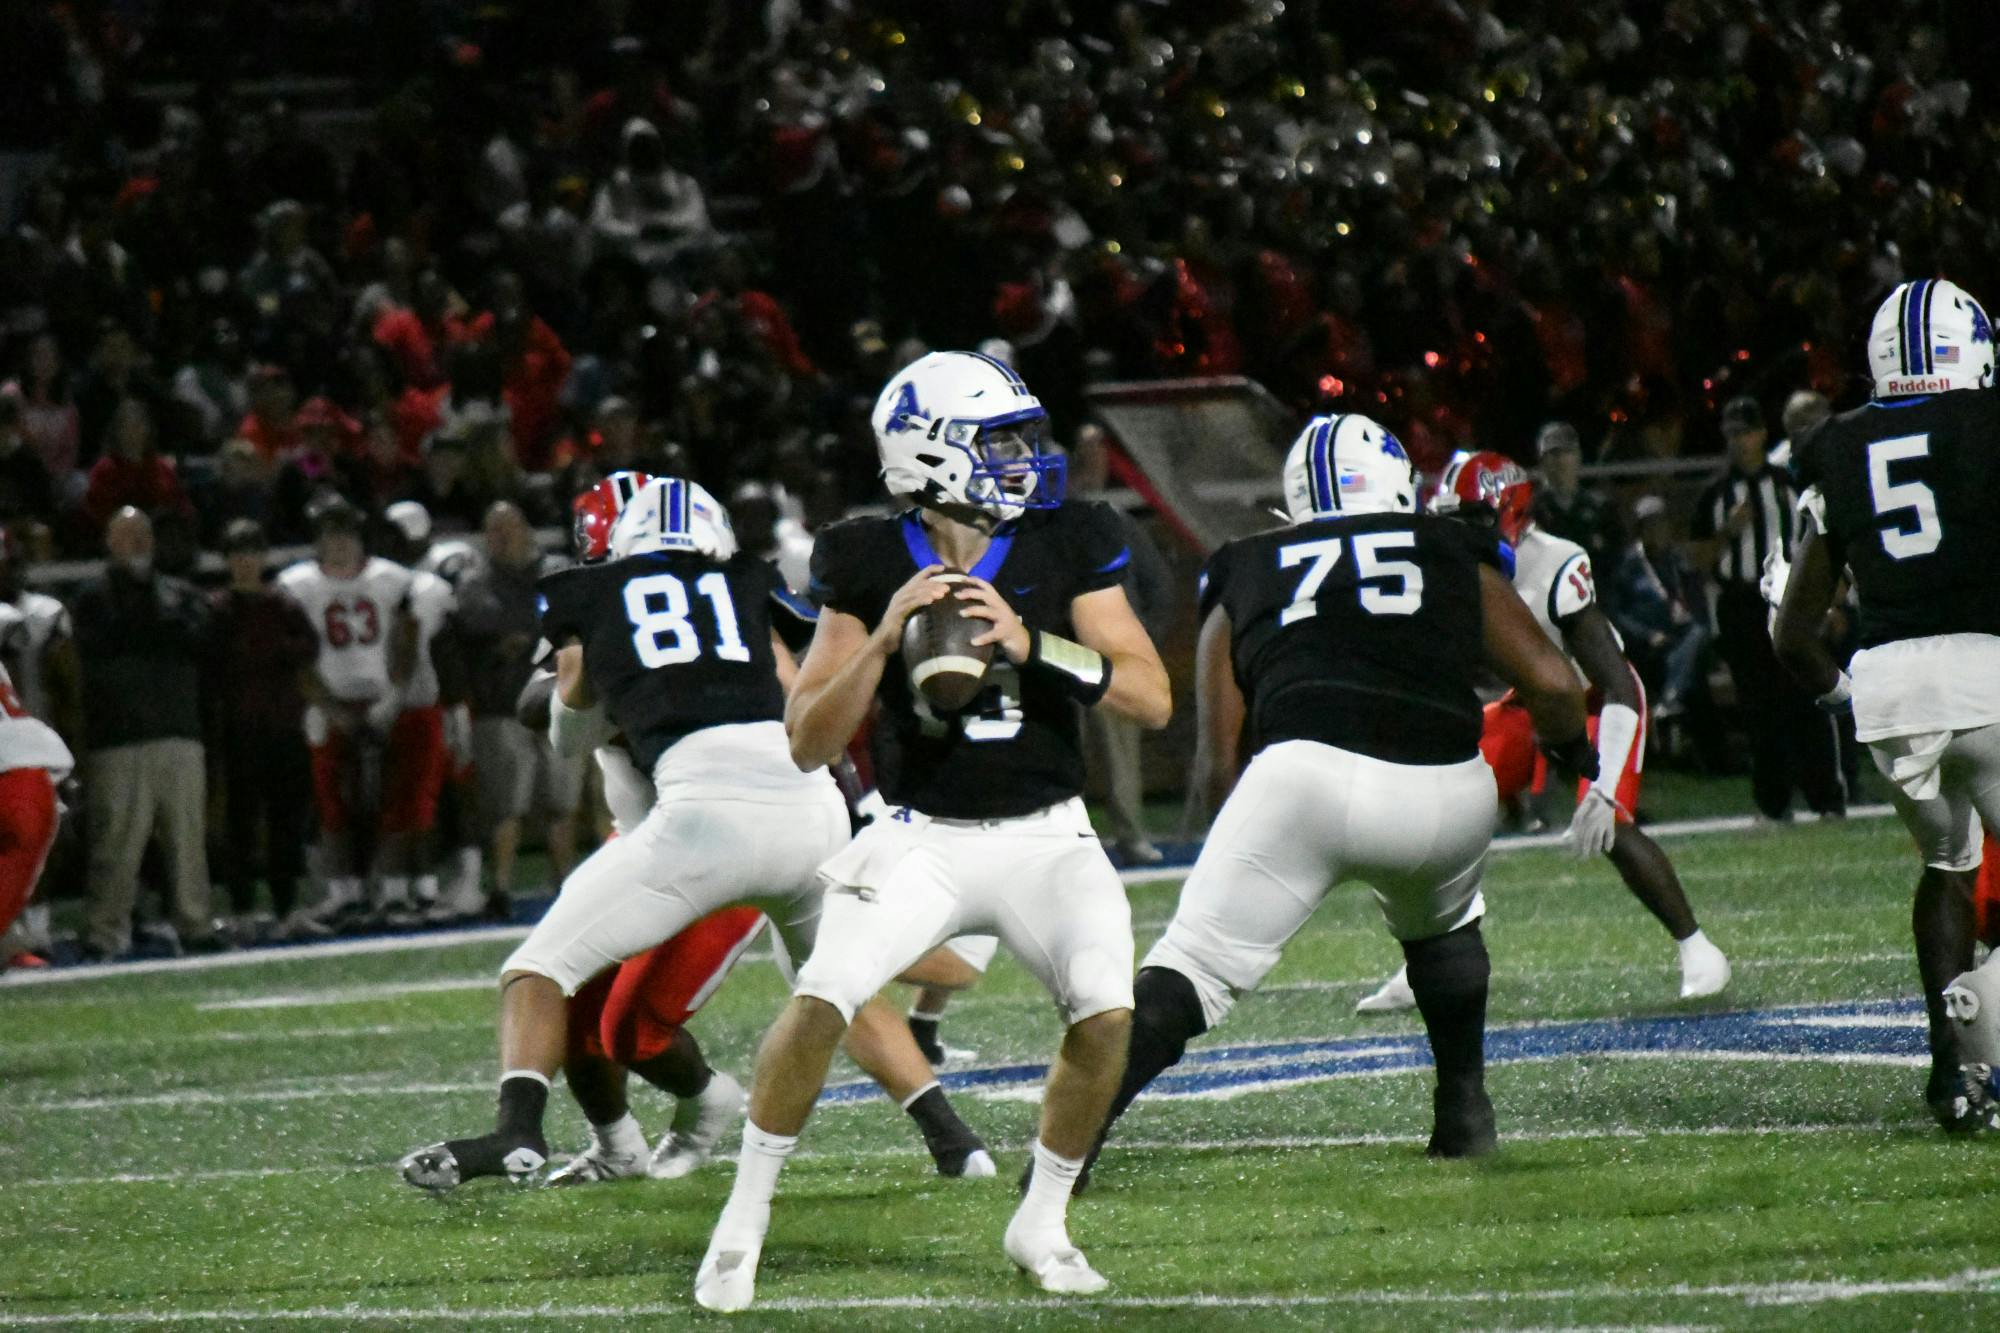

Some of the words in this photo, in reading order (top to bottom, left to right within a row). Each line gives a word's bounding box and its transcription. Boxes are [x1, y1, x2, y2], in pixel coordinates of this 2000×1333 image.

[1888, 377, 1951, 394] Riddell
[1867, 433, 1942, 560] 5
[324, 599, 380, 648] 63
[622, 572, 751, 669] 81
[1278, 530, 1424, 627] 75
